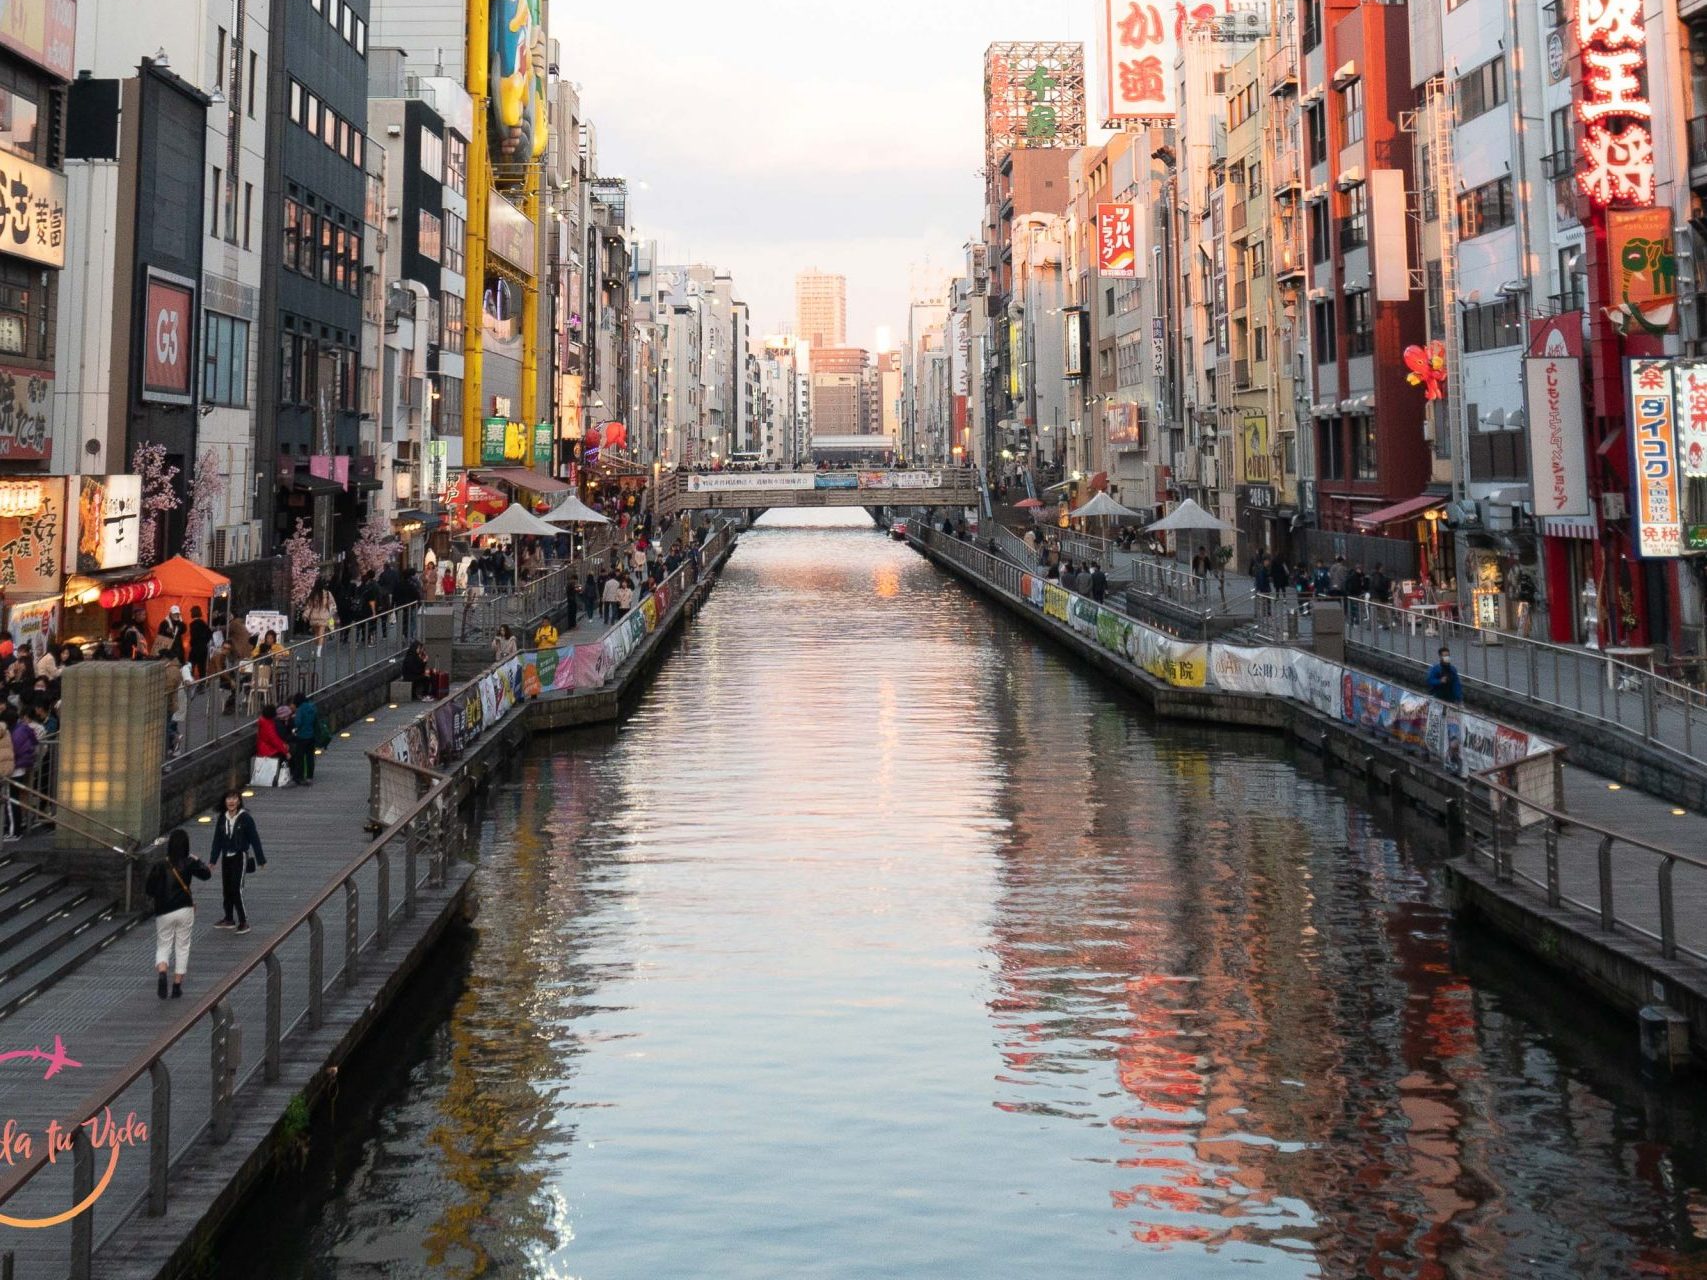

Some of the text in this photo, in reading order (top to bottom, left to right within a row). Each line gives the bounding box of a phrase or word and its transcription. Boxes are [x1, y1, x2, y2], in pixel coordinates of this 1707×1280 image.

[1102, 214, 1116, 259] ドラッグ
[1116, 208, 1131, 248] ツルハ
[156, 308, 178, 365] G3
[1641, 397, 1670, 479] ダイコク
